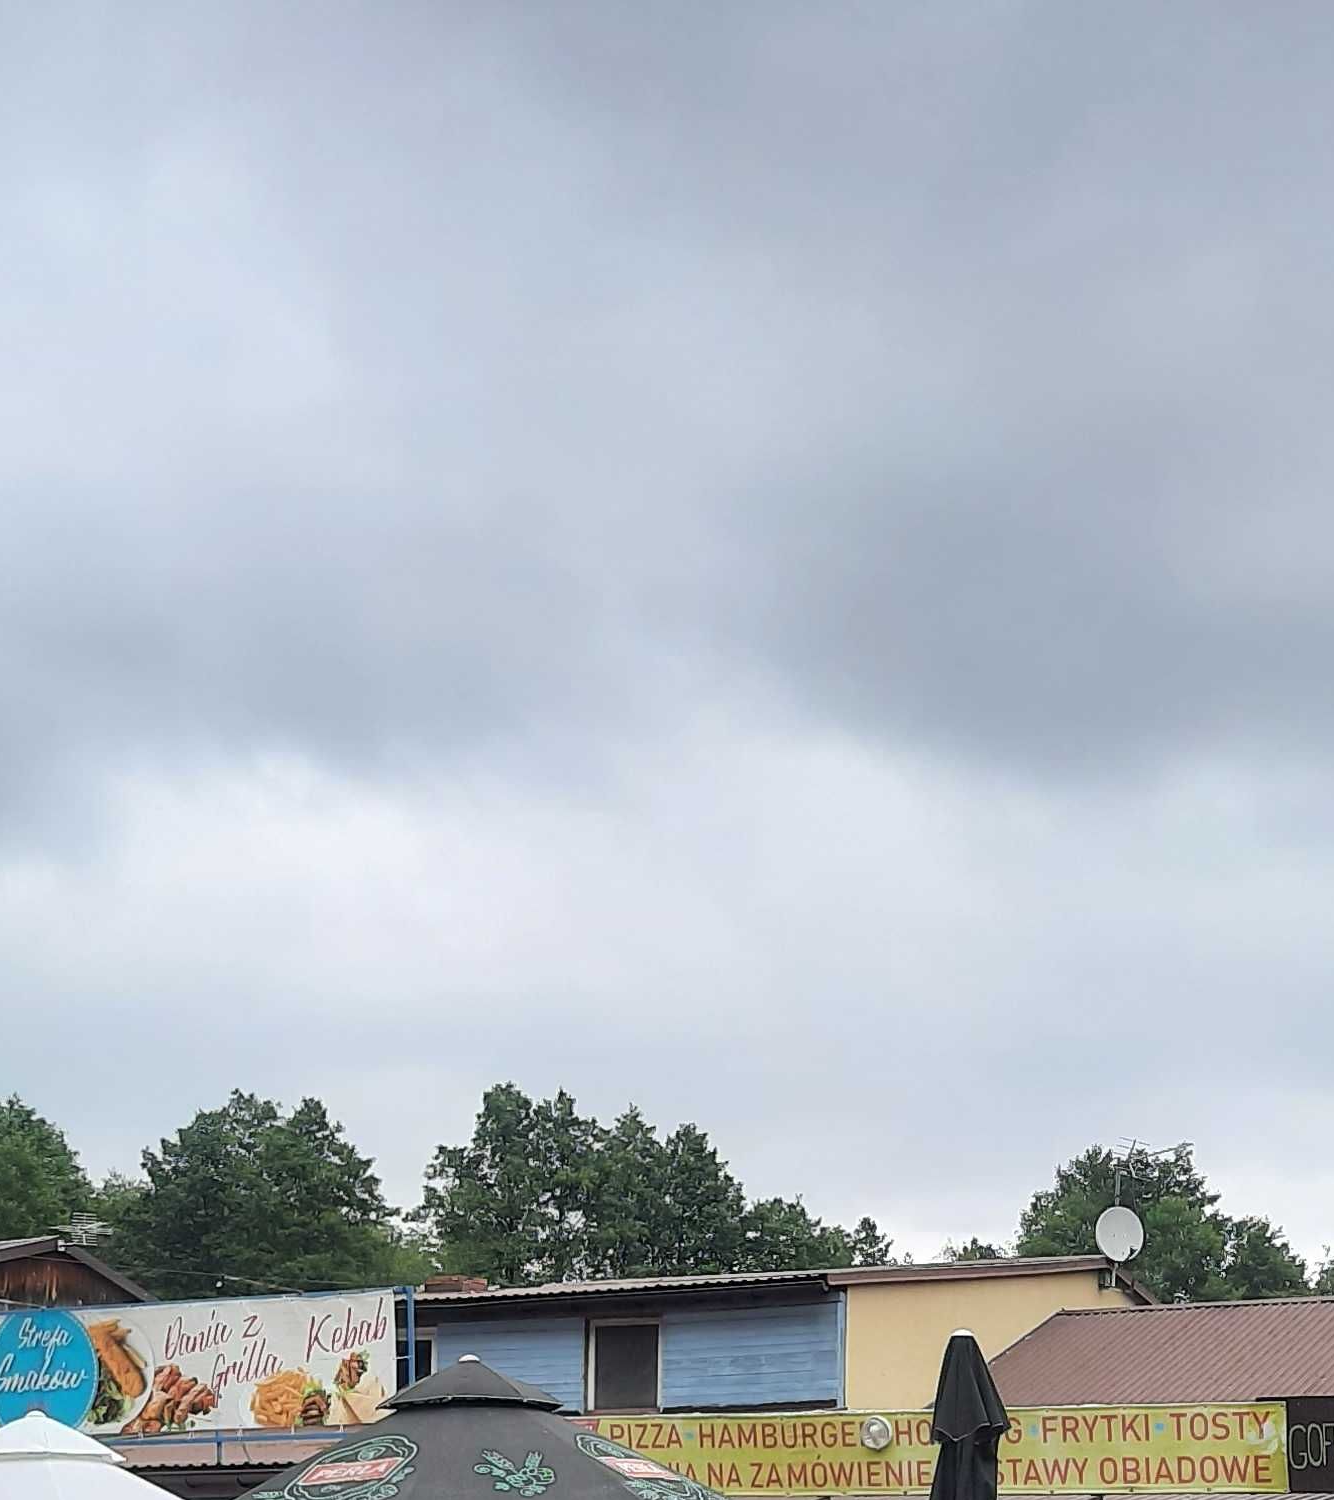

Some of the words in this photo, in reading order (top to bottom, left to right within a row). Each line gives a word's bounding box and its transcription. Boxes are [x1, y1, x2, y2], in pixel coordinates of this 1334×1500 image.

[17, 1317, 74, 1365] Strefa
[164, 1310, 233, 1360] Dania
[305, 1297, 388, 1362] Kebab
[211, 1338, 284, 1408] Grilla
[610, 1423, 683, 1449] PIZZA
[699, 1420, 867, 1449] HAMBURGE
[1041, 1413, 1151, 1444] FRYTKI
[1169, 1411, 1271, 1441] TOSTY
[707, 1465, 742, 1488] NA
[749, 1454, 933, 1489] ZAMÓWIENIE
[1099, 1454, 1273, 1485] OBIADOWE
